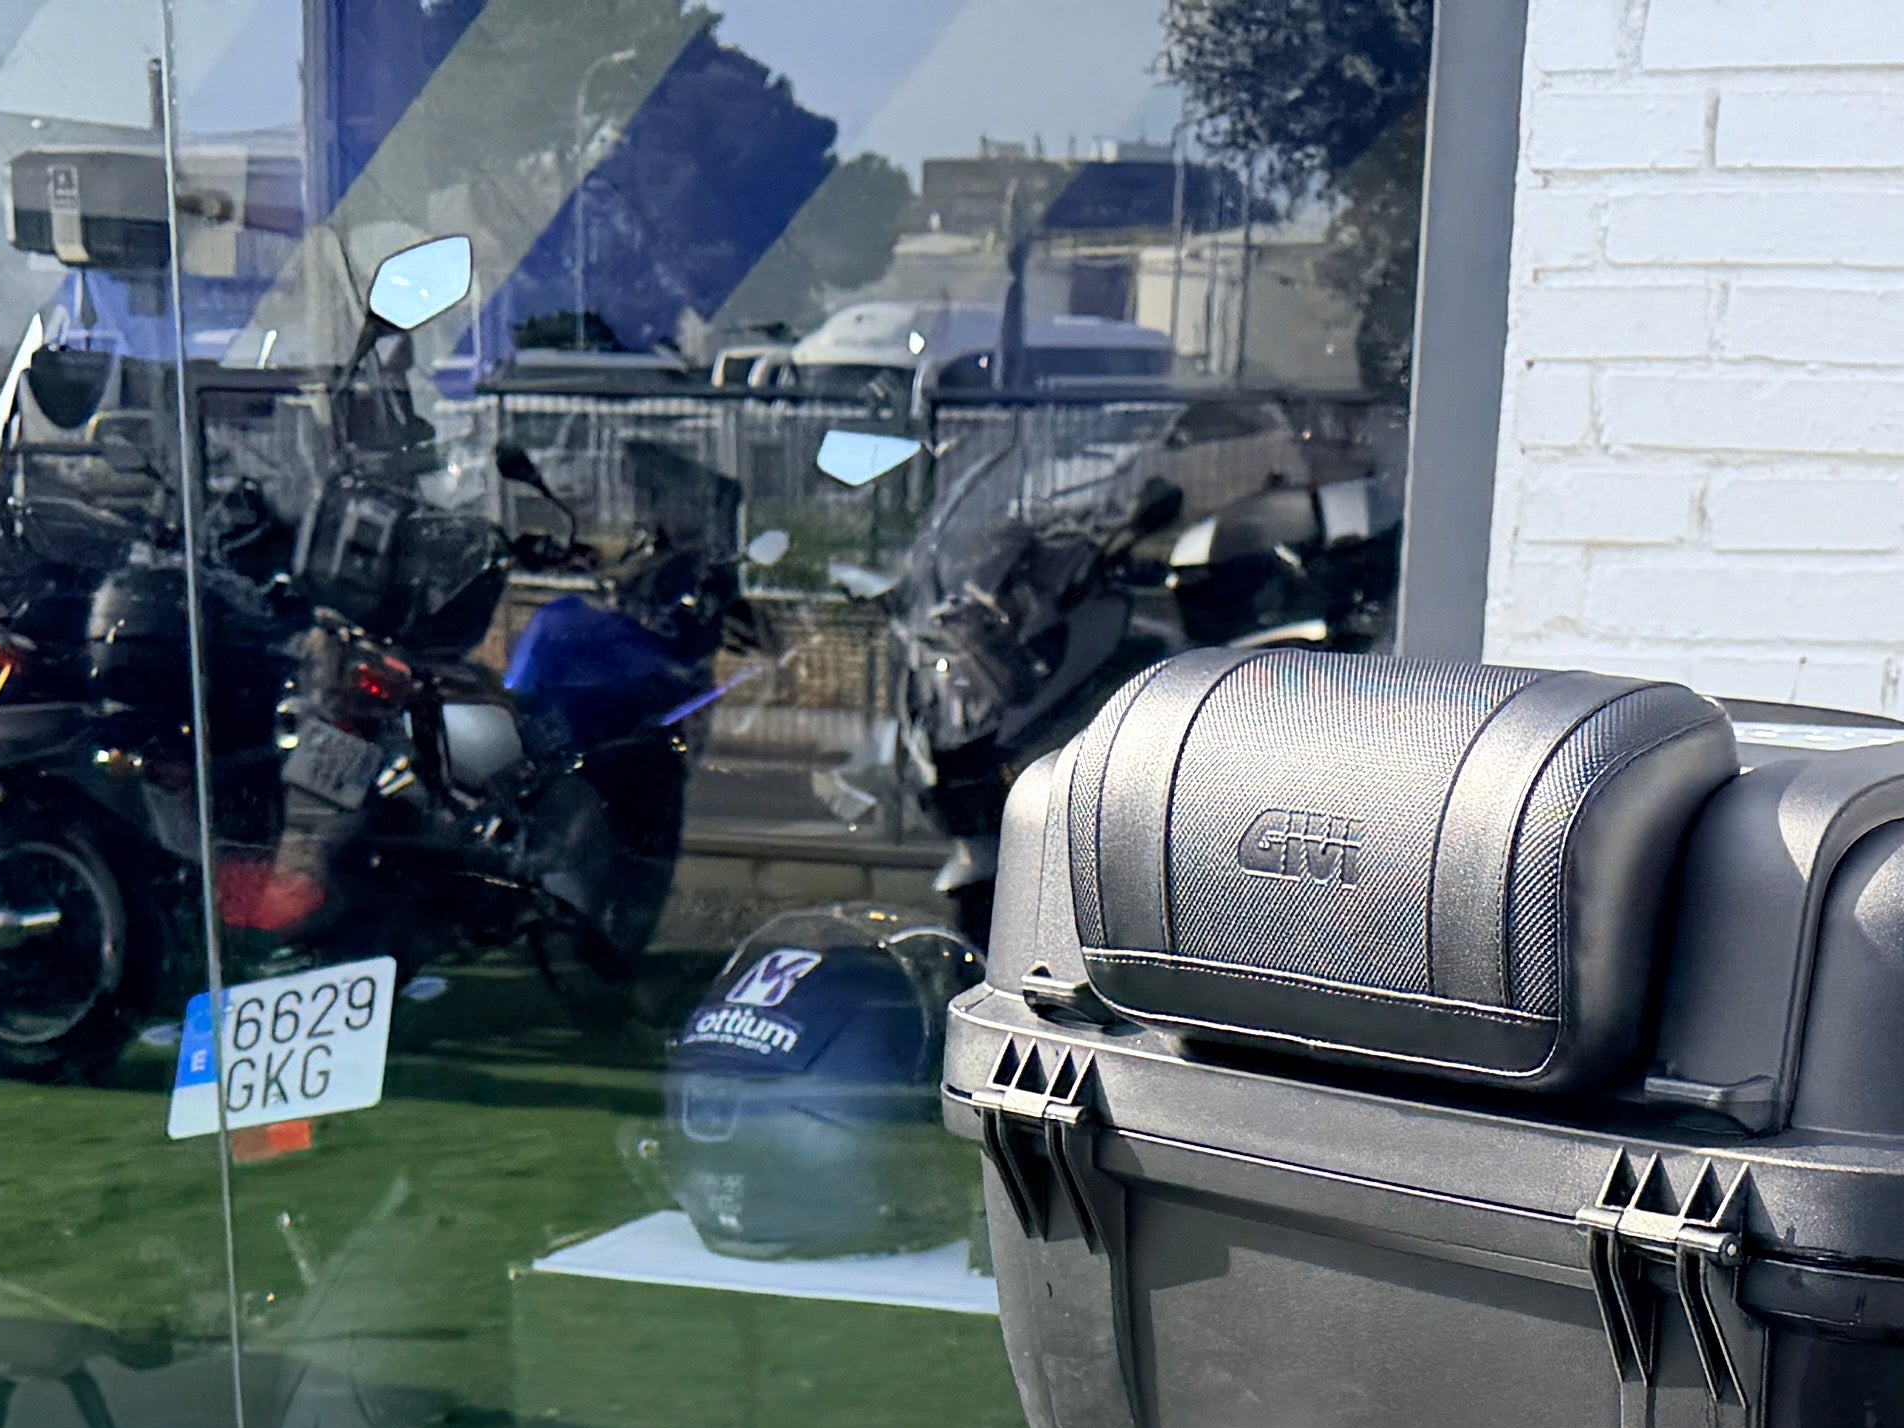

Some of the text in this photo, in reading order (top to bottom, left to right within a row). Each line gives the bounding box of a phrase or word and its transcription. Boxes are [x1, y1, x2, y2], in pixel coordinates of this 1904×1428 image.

[1237, 807, 1366, 891] GIVI
[232, 976, 377, 1051] 6629
[695, 1007, 799, 1054] ottium
[190, 1049, 207, 1073] E
[225, 1044, 333, 1113] GKG
